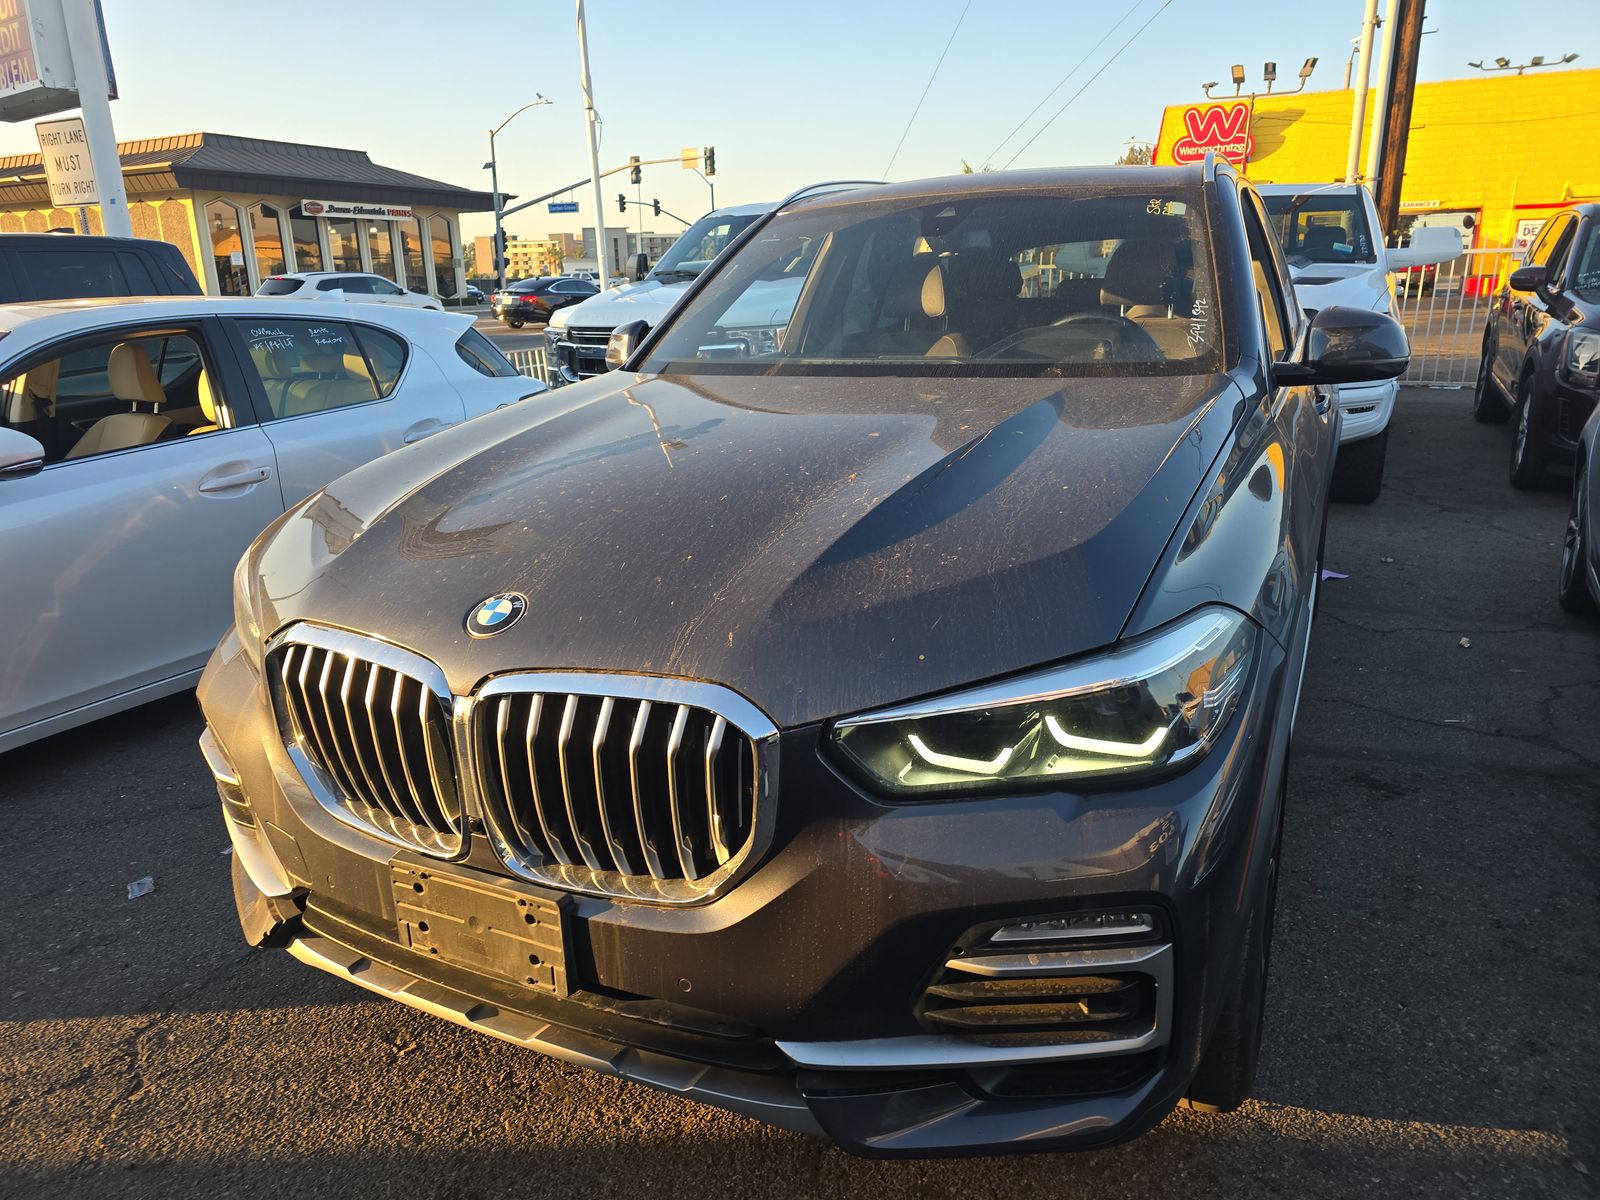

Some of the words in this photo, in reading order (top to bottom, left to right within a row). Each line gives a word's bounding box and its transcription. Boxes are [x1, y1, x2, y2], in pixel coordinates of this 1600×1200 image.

[0, 22, 20, 53] DIT
[41, 132, 62, 147] RIGHT
[64, 129, 85, 144] LANE
[1179, 142, 1247, 155] Wienerschnitze
[55, 154, 82, 172] MUST
[52, 182, 71, 197] TURN
[74, 180, 96, 194] RIGHT
[387, 209, 412, 218] PAINTS
